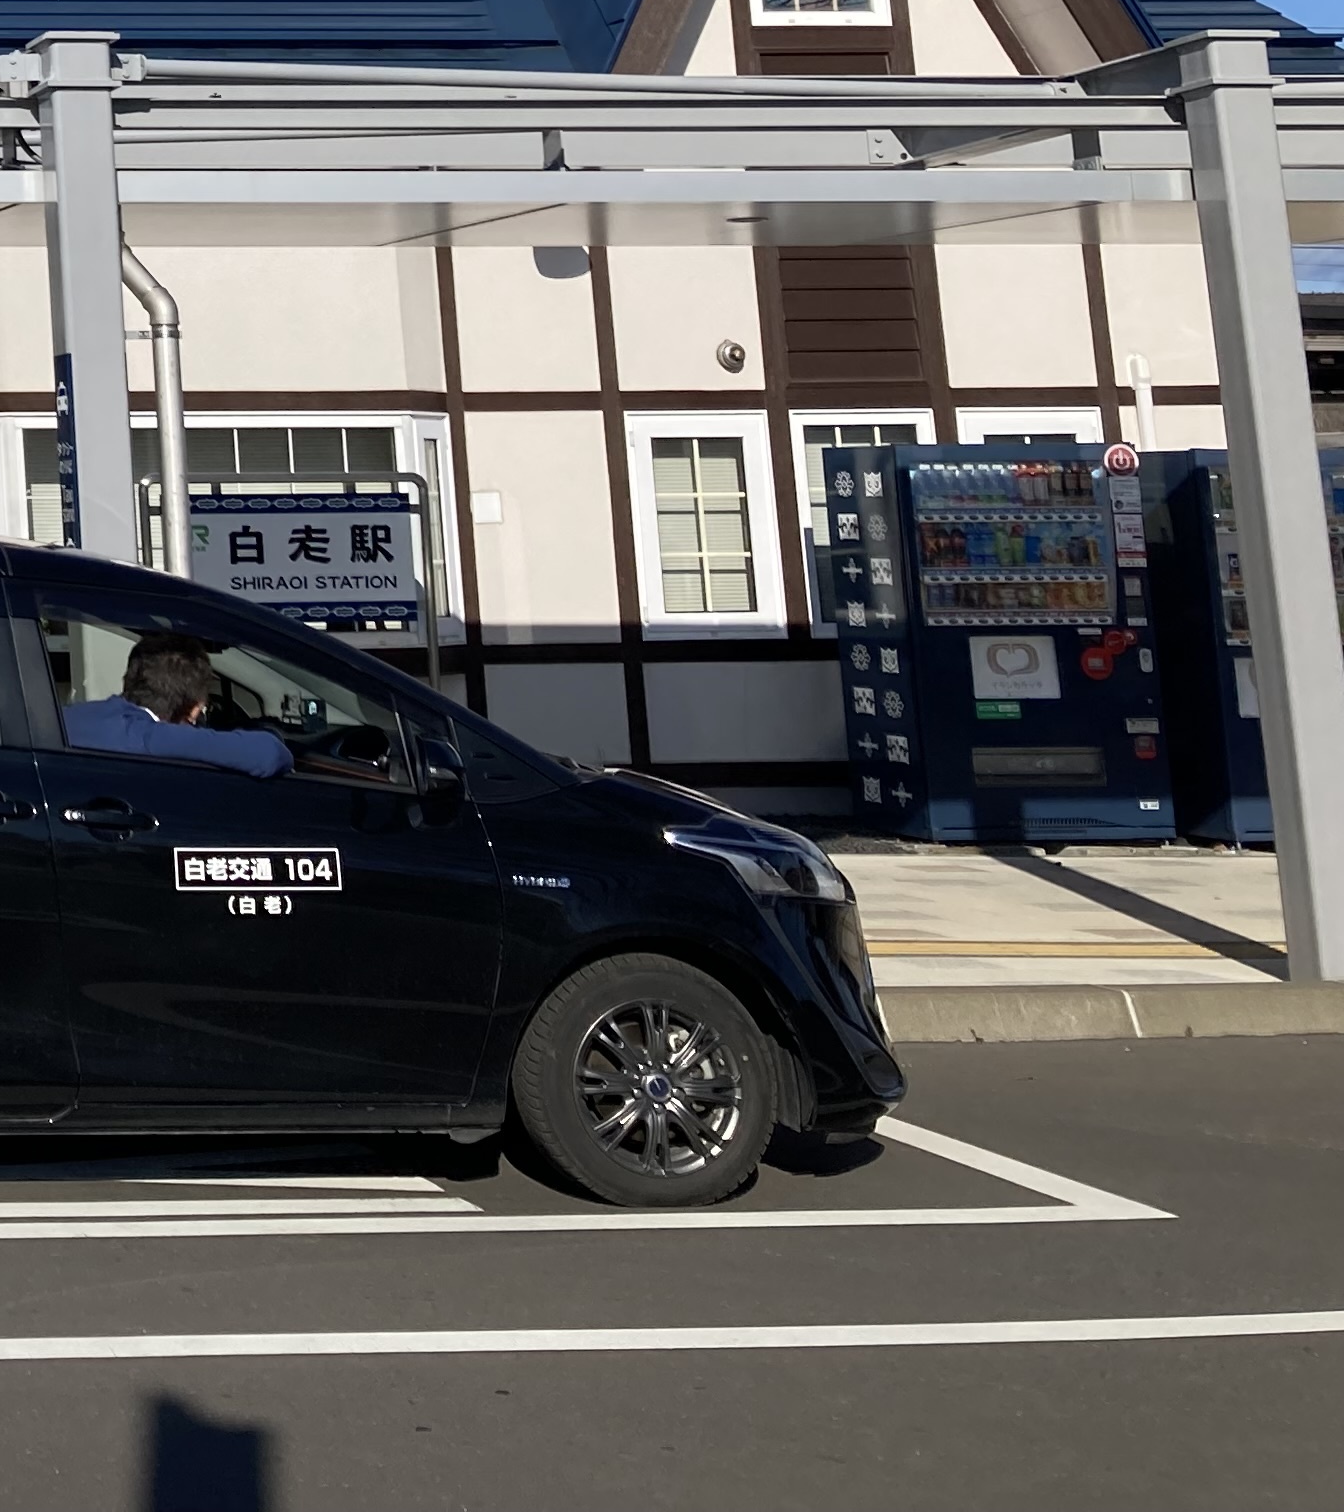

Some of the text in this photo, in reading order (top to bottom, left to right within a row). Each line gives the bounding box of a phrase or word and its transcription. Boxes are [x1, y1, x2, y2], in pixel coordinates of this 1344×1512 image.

[228, 524, 394, 565] 白老駅
[230, 575, 398, 590] SHIRAOI STATION
[184, 856, 333, 881] 白老交通 104
